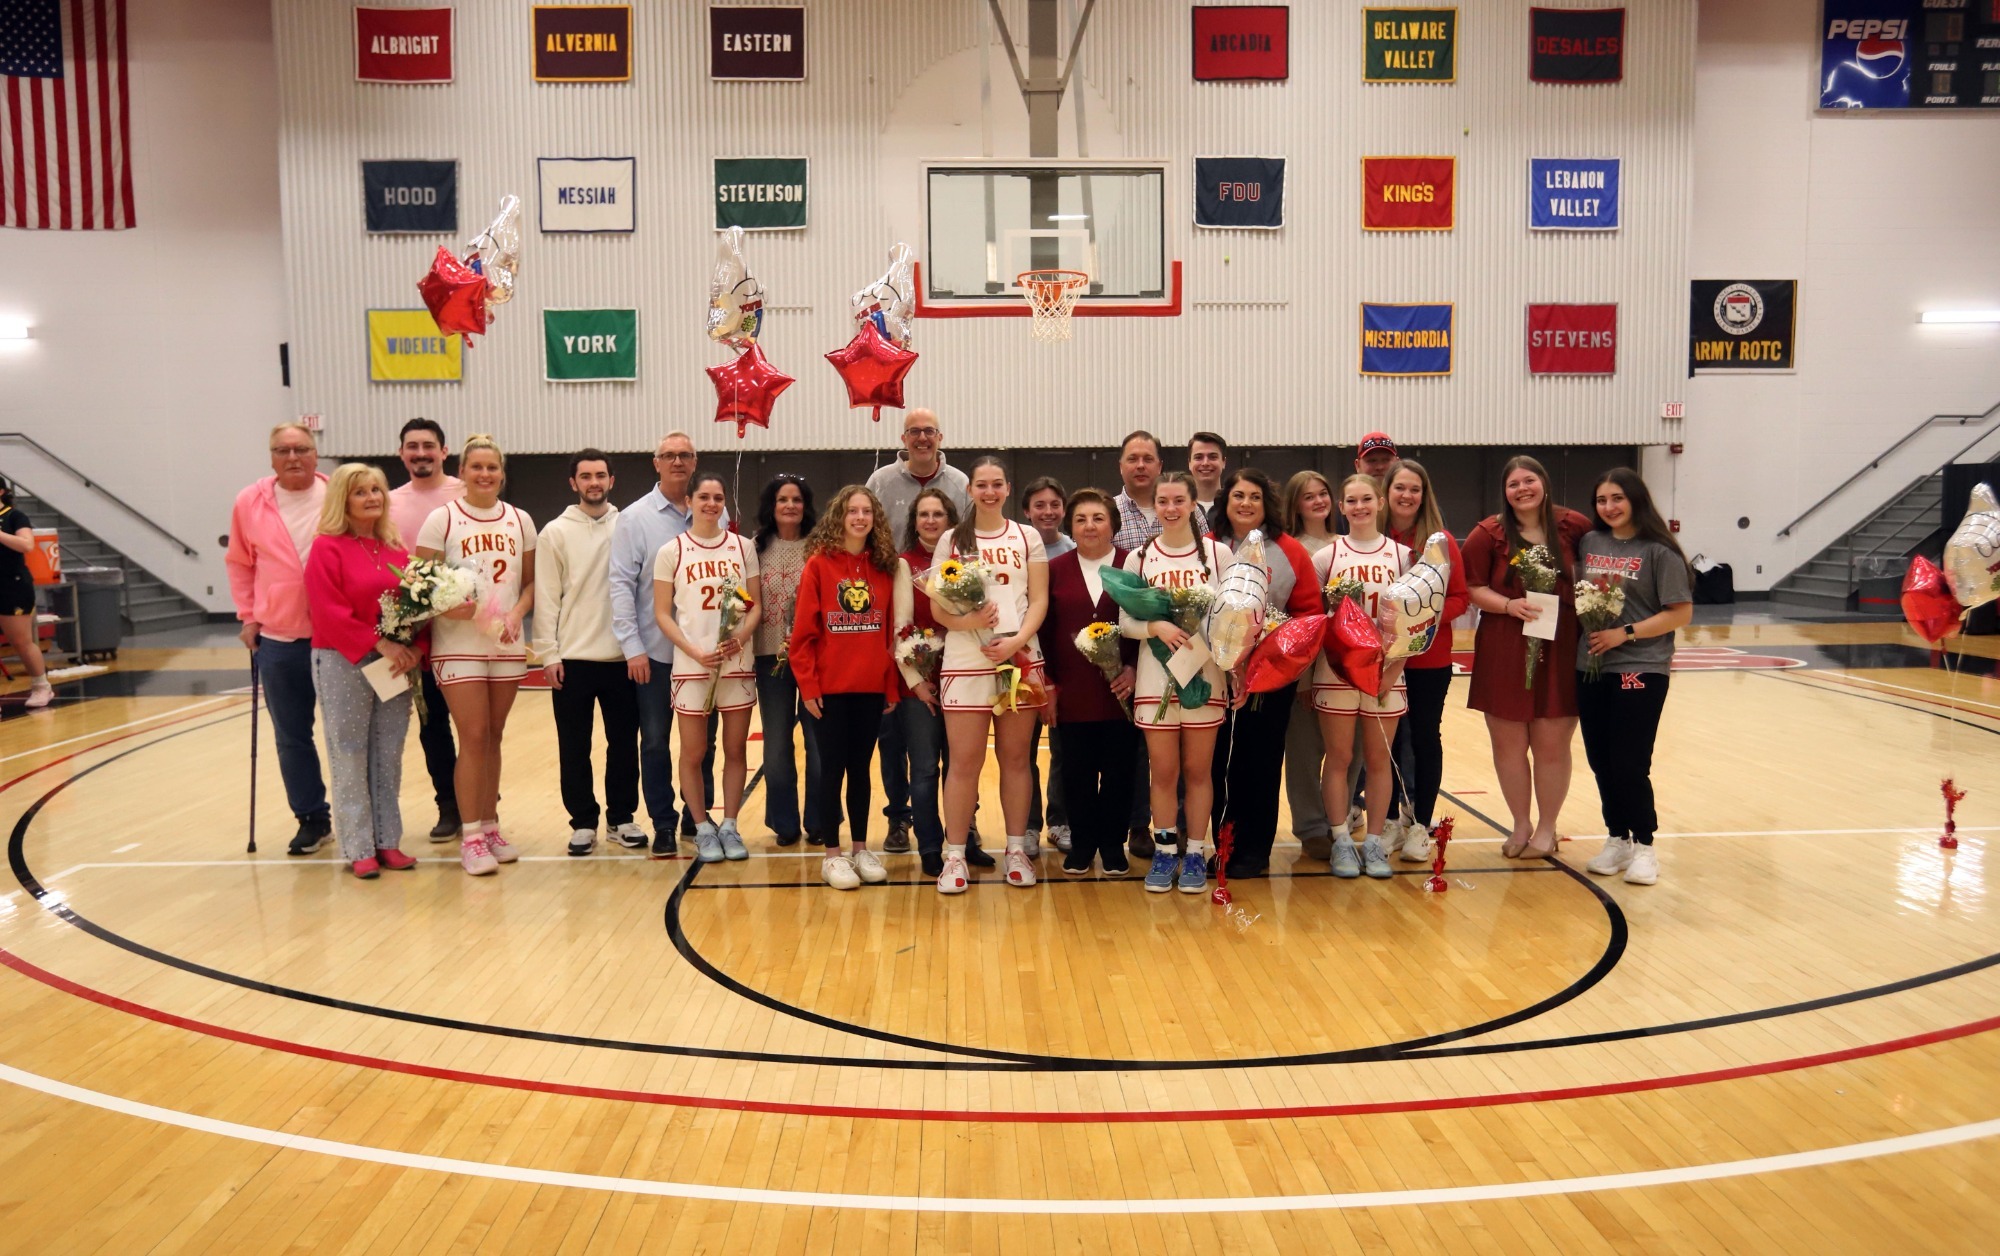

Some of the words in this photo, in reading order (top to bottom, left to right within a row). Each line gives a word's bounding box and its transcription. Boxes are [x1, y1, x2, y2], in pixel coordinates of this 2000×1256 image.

[1374, 21, 1446, 40] DELAWARE
[1827, 19, 1909, 40] PEPSI
[371, 35, 439, 55] ALBRIGHT
[546, 33, 618, 53] ALVERNIA
[723, 33, 792, 53] EASTERN
[1210, 33, 1271, 53] ARCADIA
[1536, 36, 1619, 55] DESALES
[1976, 39, 2000, 48] PER
[1384, 50, 1435, 69] VALLEY
[1929, 63, 1956, 71] FOULS
[1981, 63, 2000, 71] PLA
[1925, 96, 1955, 104] POINTS
[1546, 170, 1605, 190] LEBANON
[384, 186, 437, 206] HOOD
[558, 186, 616, 205] MESSIAH
[719, 183, 803, 203] STEVENSON
[1219, 181, 1261, 202] FDU
[1383, 181, 1434, 203] KING'S
[1550, 198, 1600, 217] VALLEY
[386, 337, 447, 355] WIDENER
[563, 334, 617, 354] YORK
[1364, 329, 1449, 350] MISERICORDIA
[1531, 330, 1613, 349] STEVENS
[1739, 340, 1782, 362] ROTC
[1666, 403, 1682, 416] EXIT
[303, 416, 319, 429] EXIT
[461, 533, 516, 559] KING'S
[981, 546, 1021, 569] NG'S
[1585, 553, 1642, 571] KING'S
[686, 558, 742, 585] KING'S
[1586, 567, 1639, 581] ASKETBALL
[828, 609, 882, 626] KING'S
[831, 624, 881, 632] BASKETBALL
[1620, 671, 1645, 690] K
